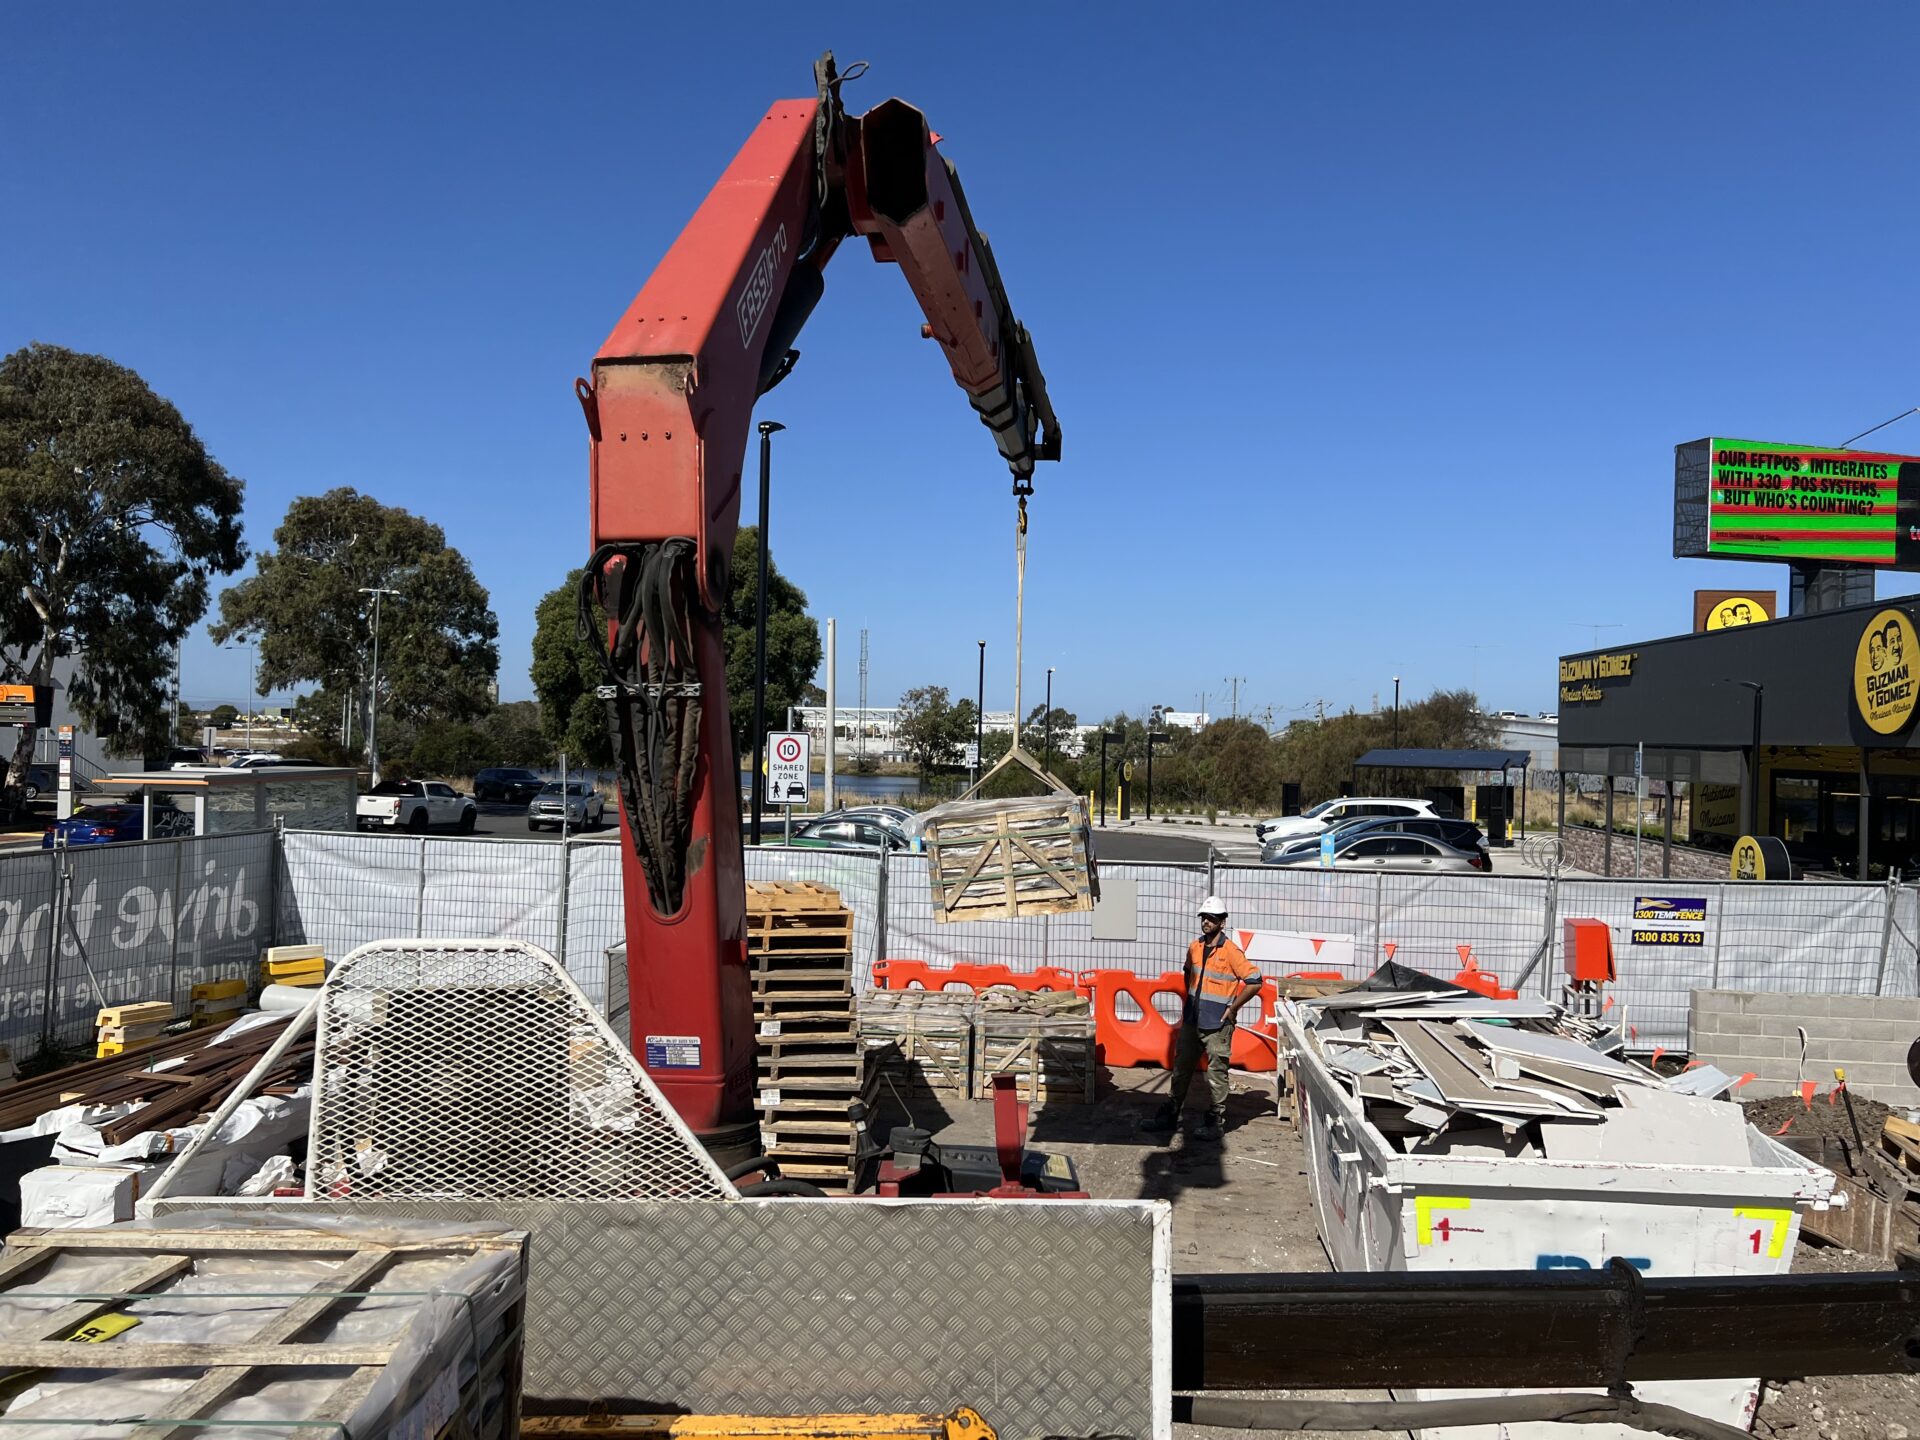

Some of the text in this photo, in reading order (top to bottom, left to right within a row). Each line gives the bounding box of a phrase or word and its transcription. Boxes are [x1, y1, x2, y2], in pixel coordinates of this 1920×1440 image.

[740, 260, 770, 338] FASSI
[1718, 450, 1888, 479] OUR EFTPOS INTEGRATES
[1718, 469, 1881, 498] WITH 330 POS SYSTEMS.
[1723, 489, 1874, 516] BUT WHO'S COUNTING?
[1560, 654, 1631, 682] GUZMAN Y GOMEZ
[1866, 664, 1909, 693] GUZMAN
[1867, 681, 1912, 710] Y GOMEZ
[1869, 710, 1892, 721] Mexican
[783, 744, 795, 755] 10
[1634, 931, 1701, 943] 1300 836 733
[1437, 1217, 1449, 1241] 1
[1749, 1229, 1761, 1254] 1
